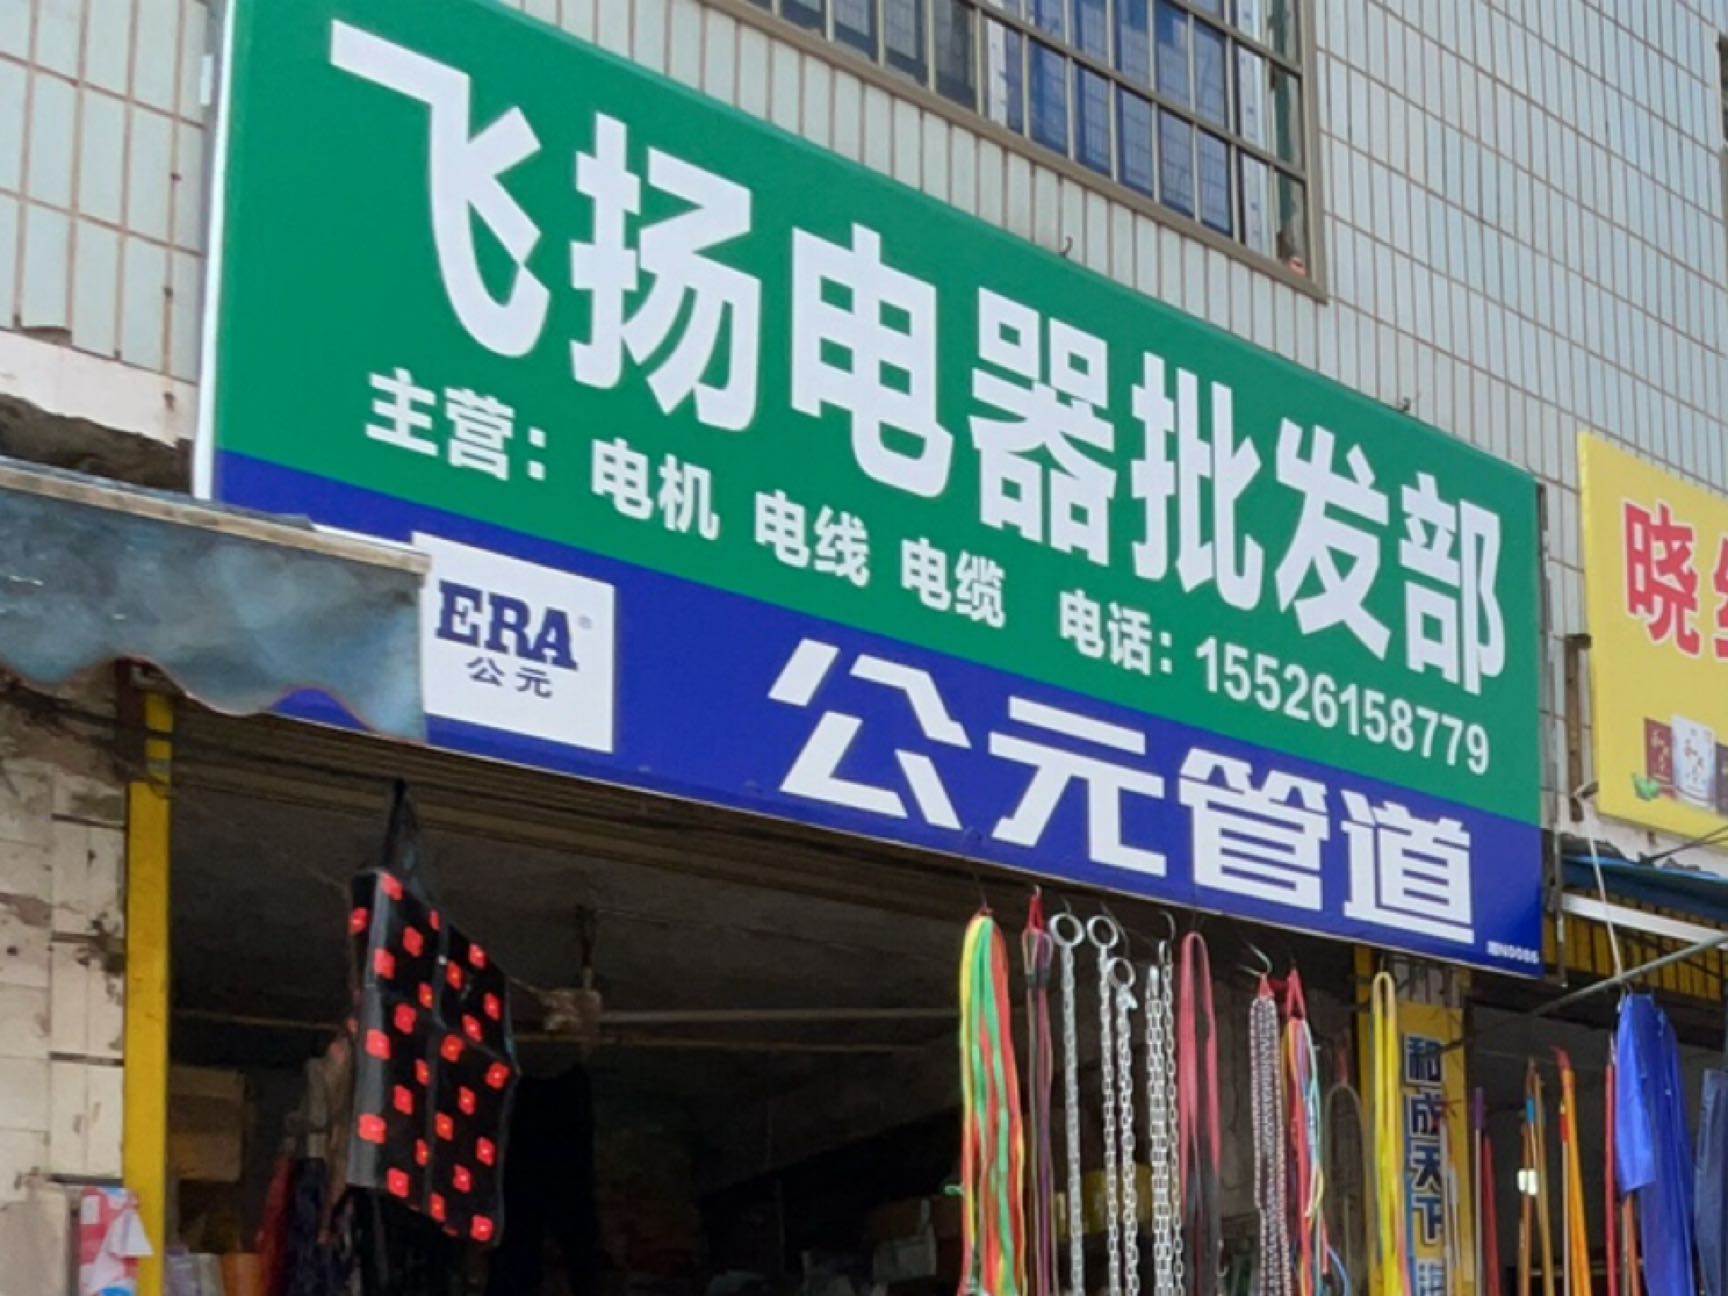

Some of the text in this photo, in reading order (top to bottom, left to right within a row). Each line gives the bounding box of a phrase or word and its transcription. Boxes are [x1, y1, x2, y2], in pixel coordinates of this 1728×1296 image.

[329, 19, 1505, 697] 飞扬电器批发部
[365, 367, 1490, 775] 主营： 电机 电线 电缆 电话： 15526158779
[434, 578, 579, 671] ERA
[466, 656, 553, 699] 公元
[766, 637, 1475, 944] 公元管道
